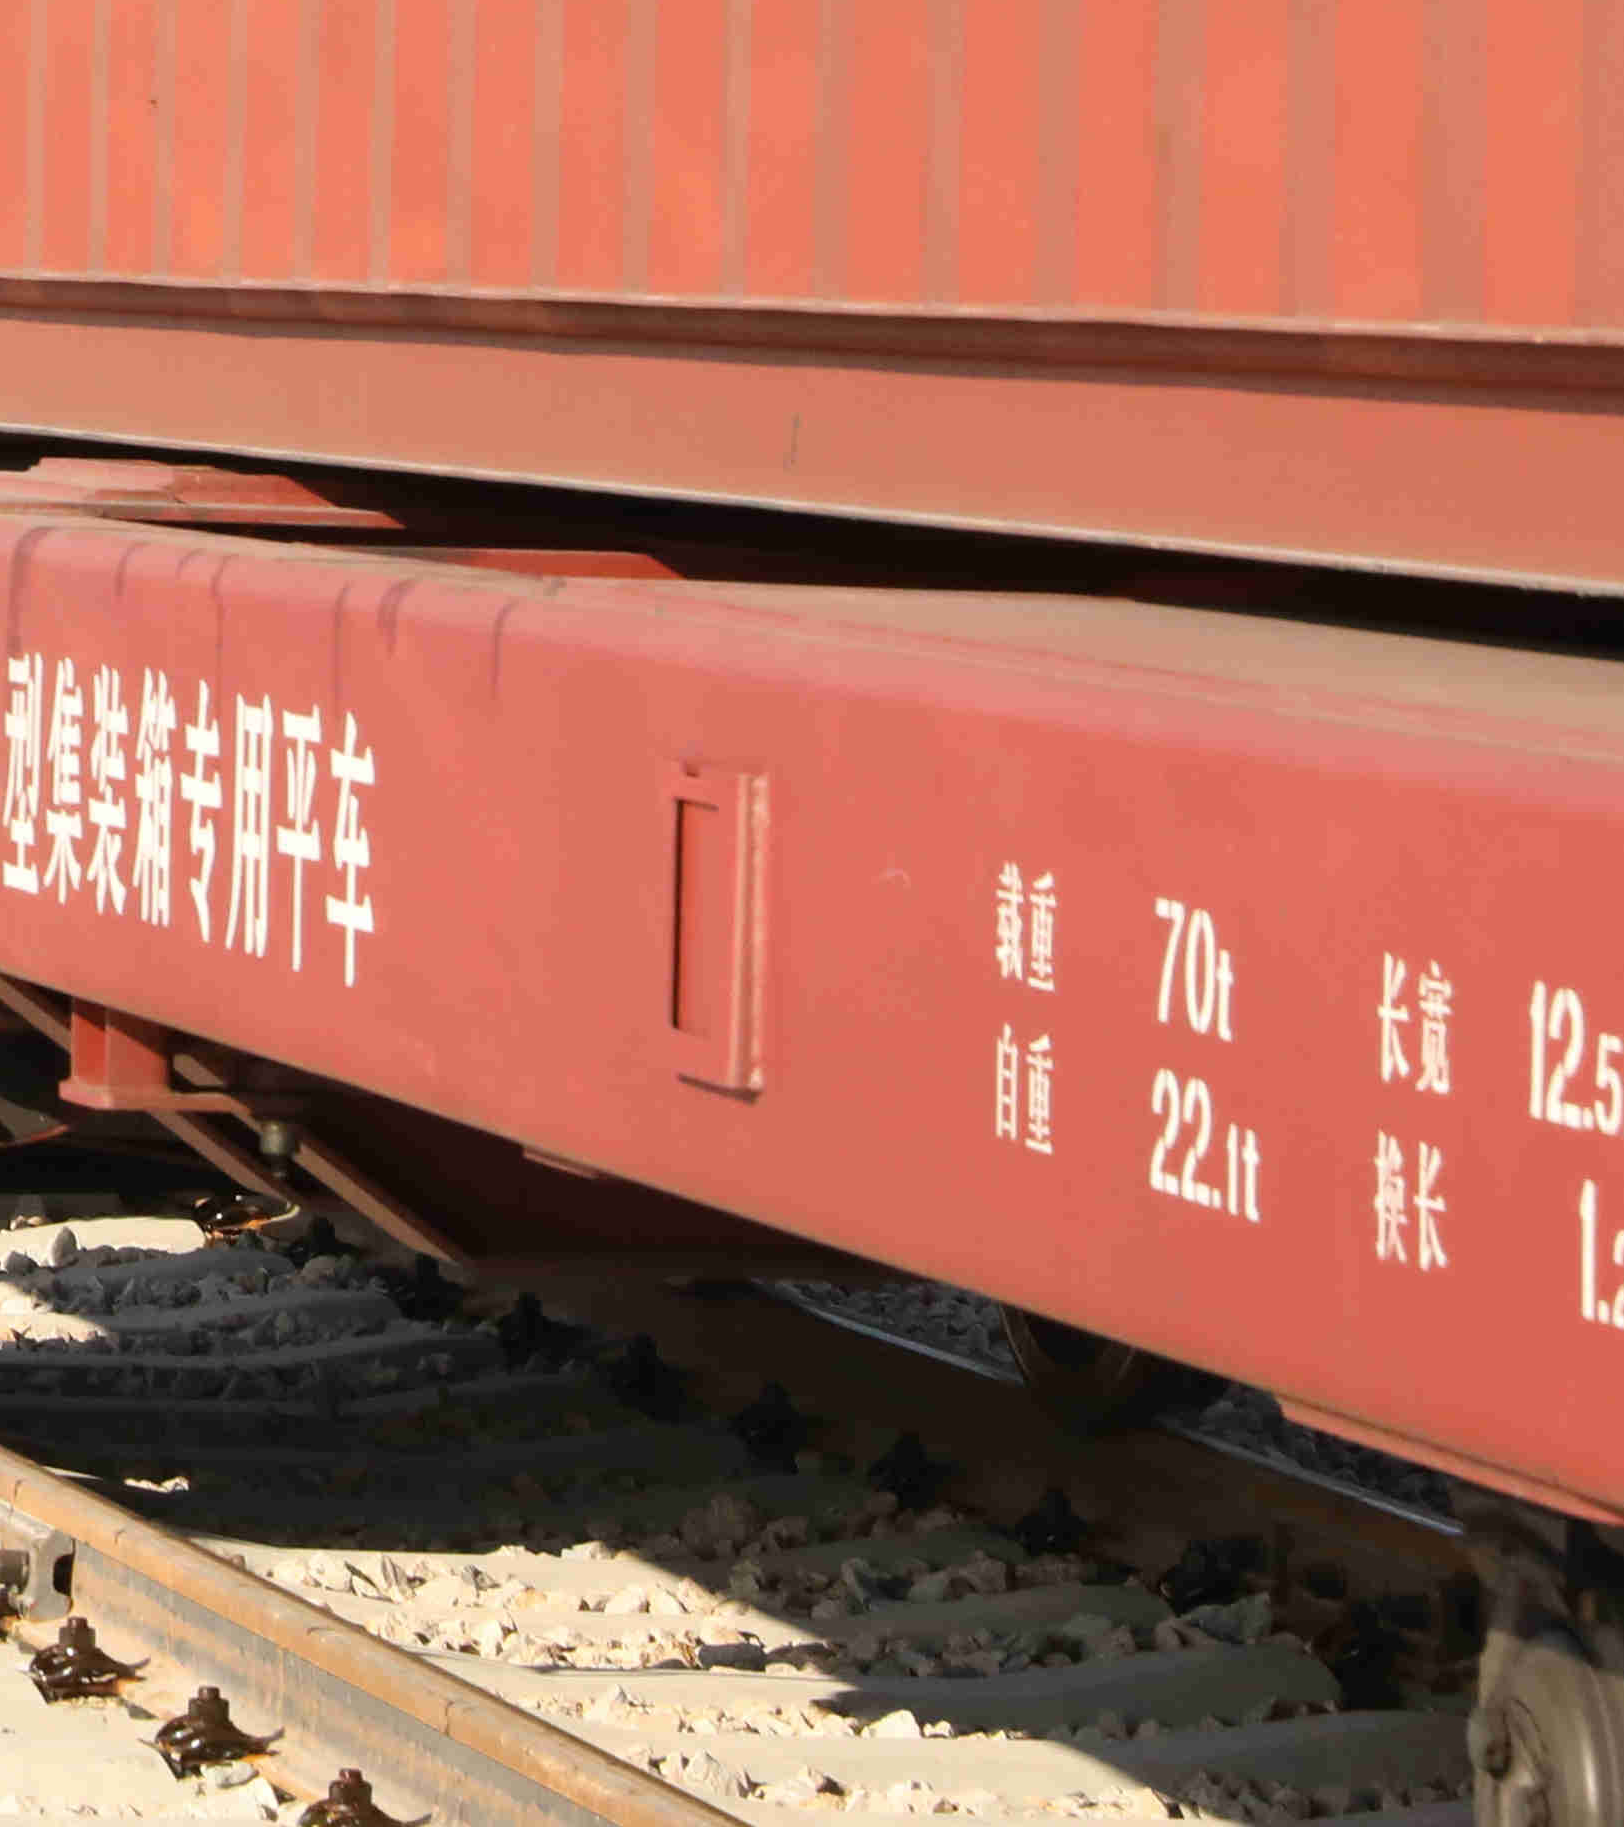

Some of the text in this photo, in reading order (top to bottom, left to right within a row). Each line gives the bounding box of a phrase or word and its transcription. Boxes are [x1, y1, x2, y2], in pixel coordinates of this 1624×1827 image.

[1154, 895, 1235, 1043] 70t
[1376, 950, 1455, 1095] 长宽
[995, 1022, 1262, 1224] 自重 22.1t
[1373, 1129, 1449, 1274] 换长
